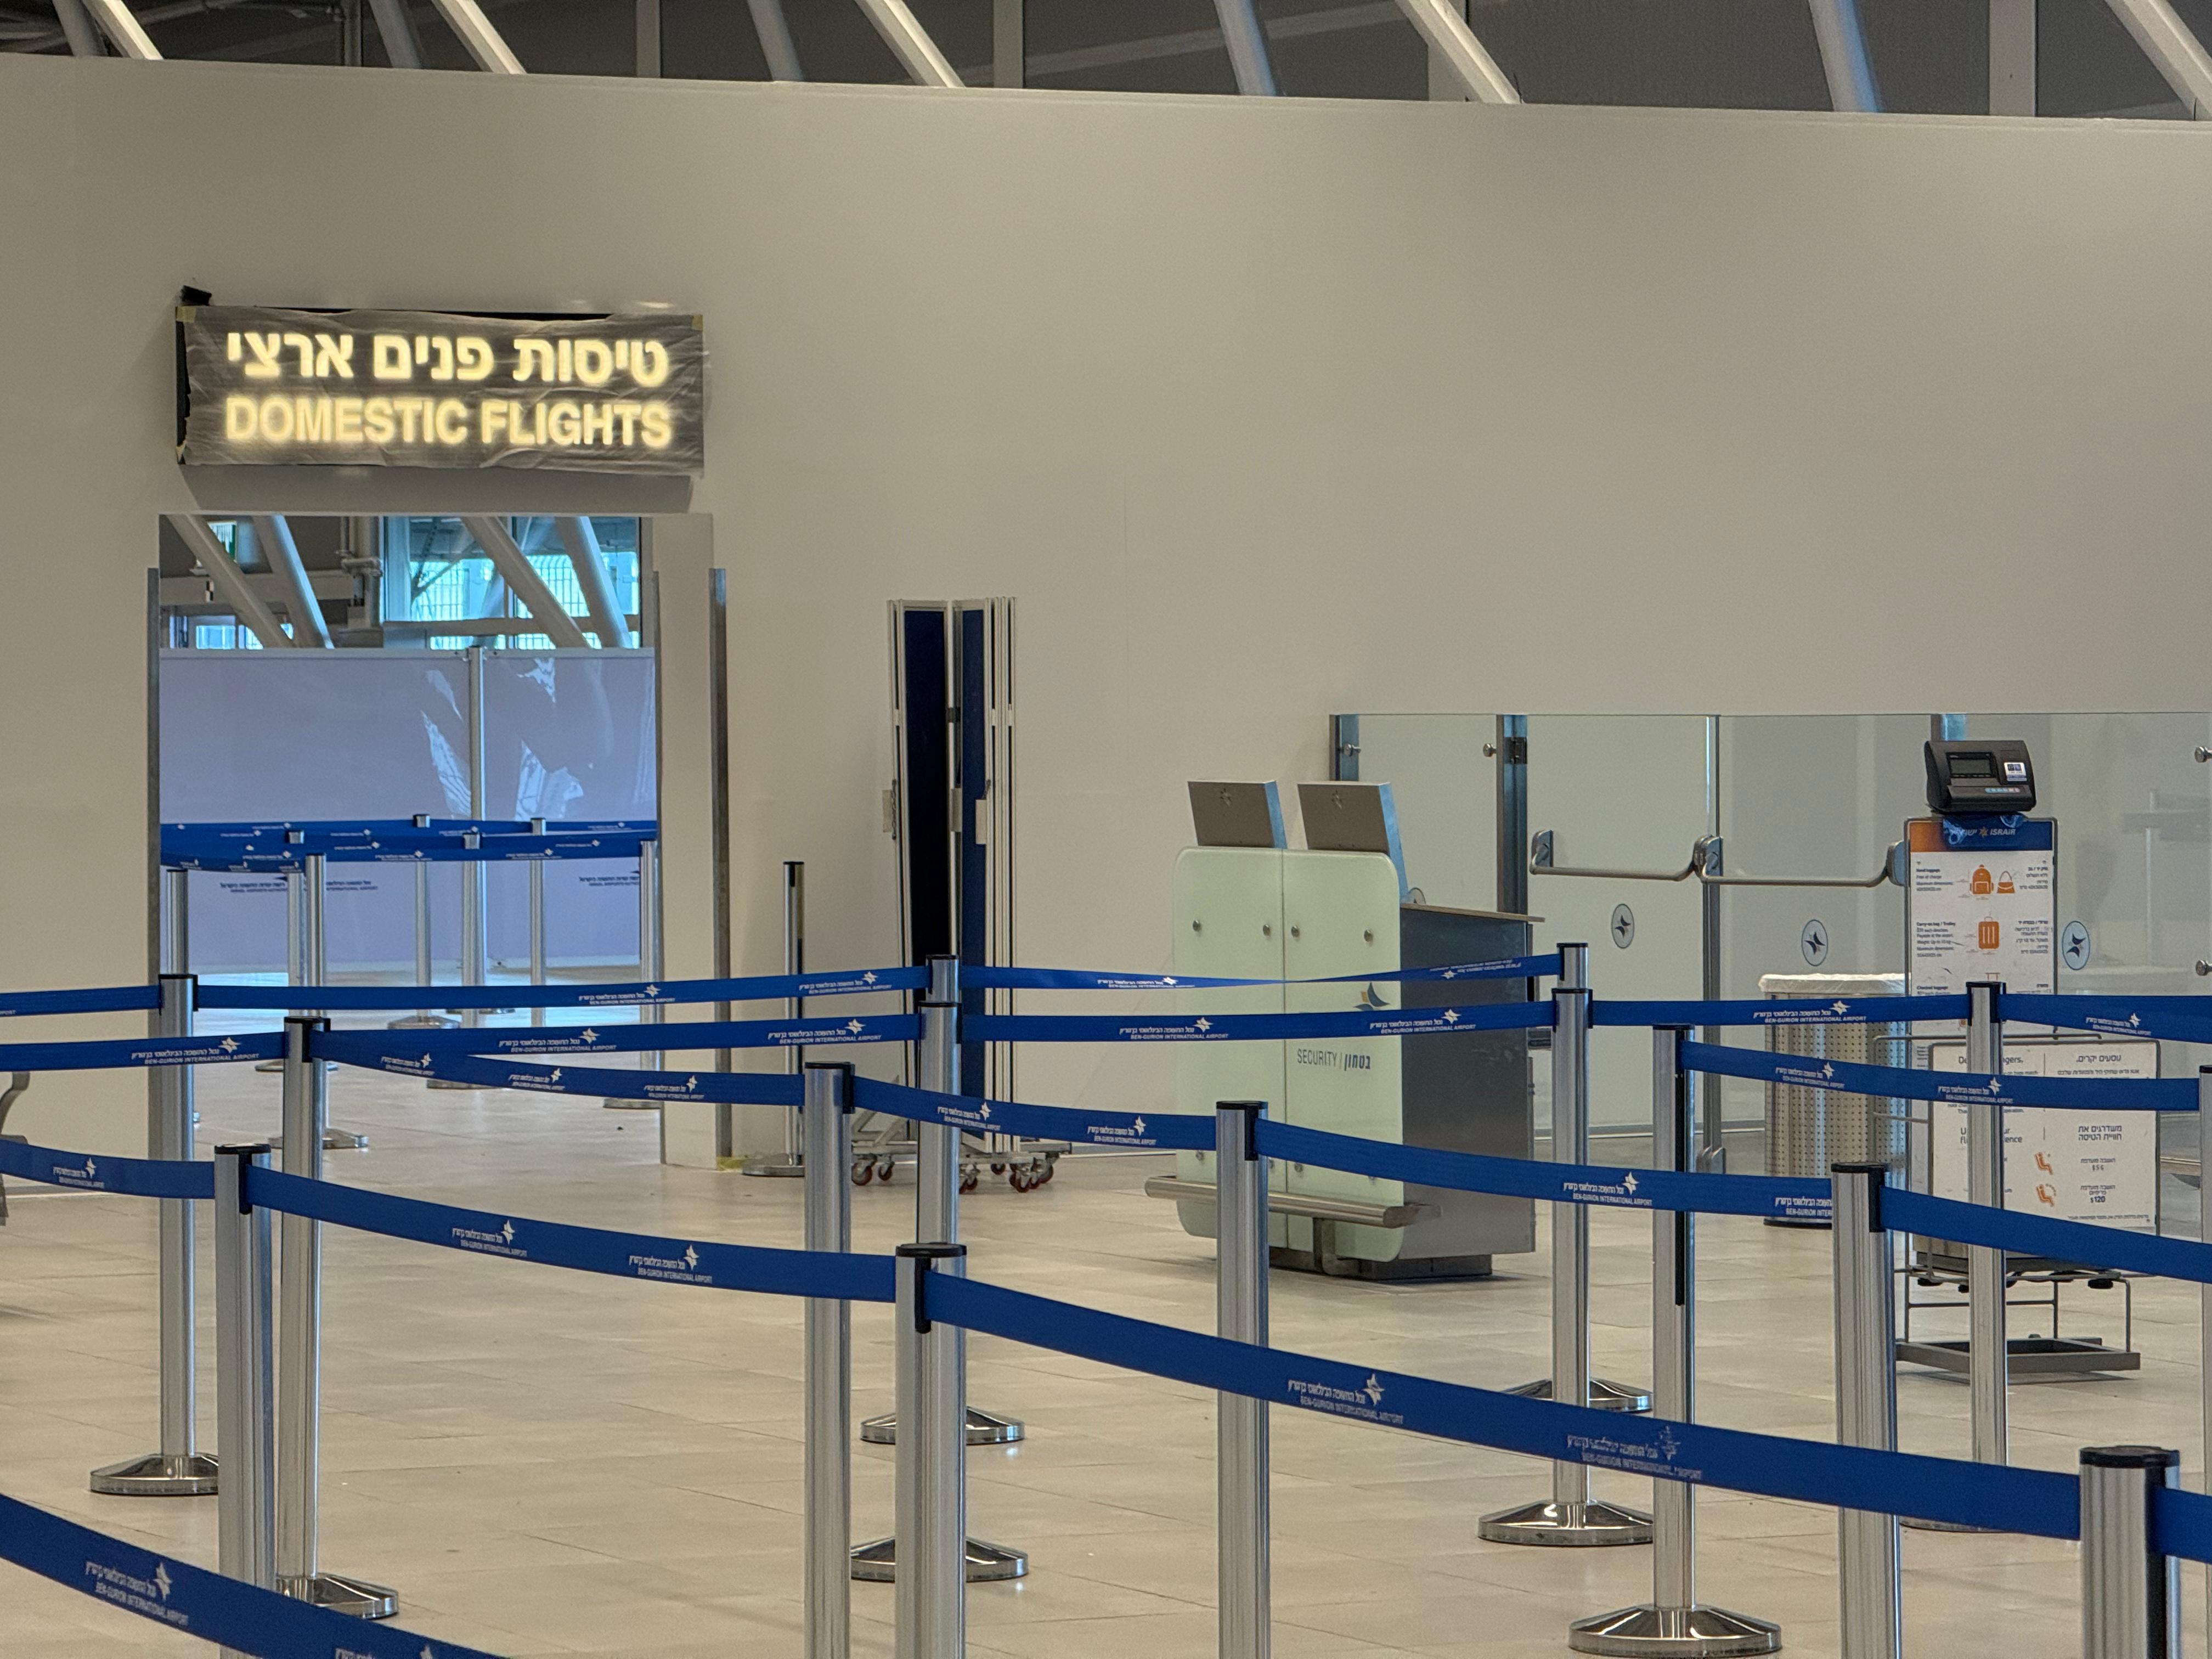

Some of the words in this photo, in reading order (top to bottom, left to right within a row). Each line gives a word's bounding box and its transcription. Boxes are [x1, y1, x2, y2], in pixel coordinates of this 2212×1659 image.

[227, 332, 353, 379] ארצי
[374, 335, 493, 381] פנים
[514, 339, 670, 387] טיסות
[226, 396, 468, 444] DOMESTIC
[481, 400, 673, 448] FLIGHTS
[1297, 1048, 1338, 1067] SECURITY
[1344, 1054, 1370, 1071] בטחון
